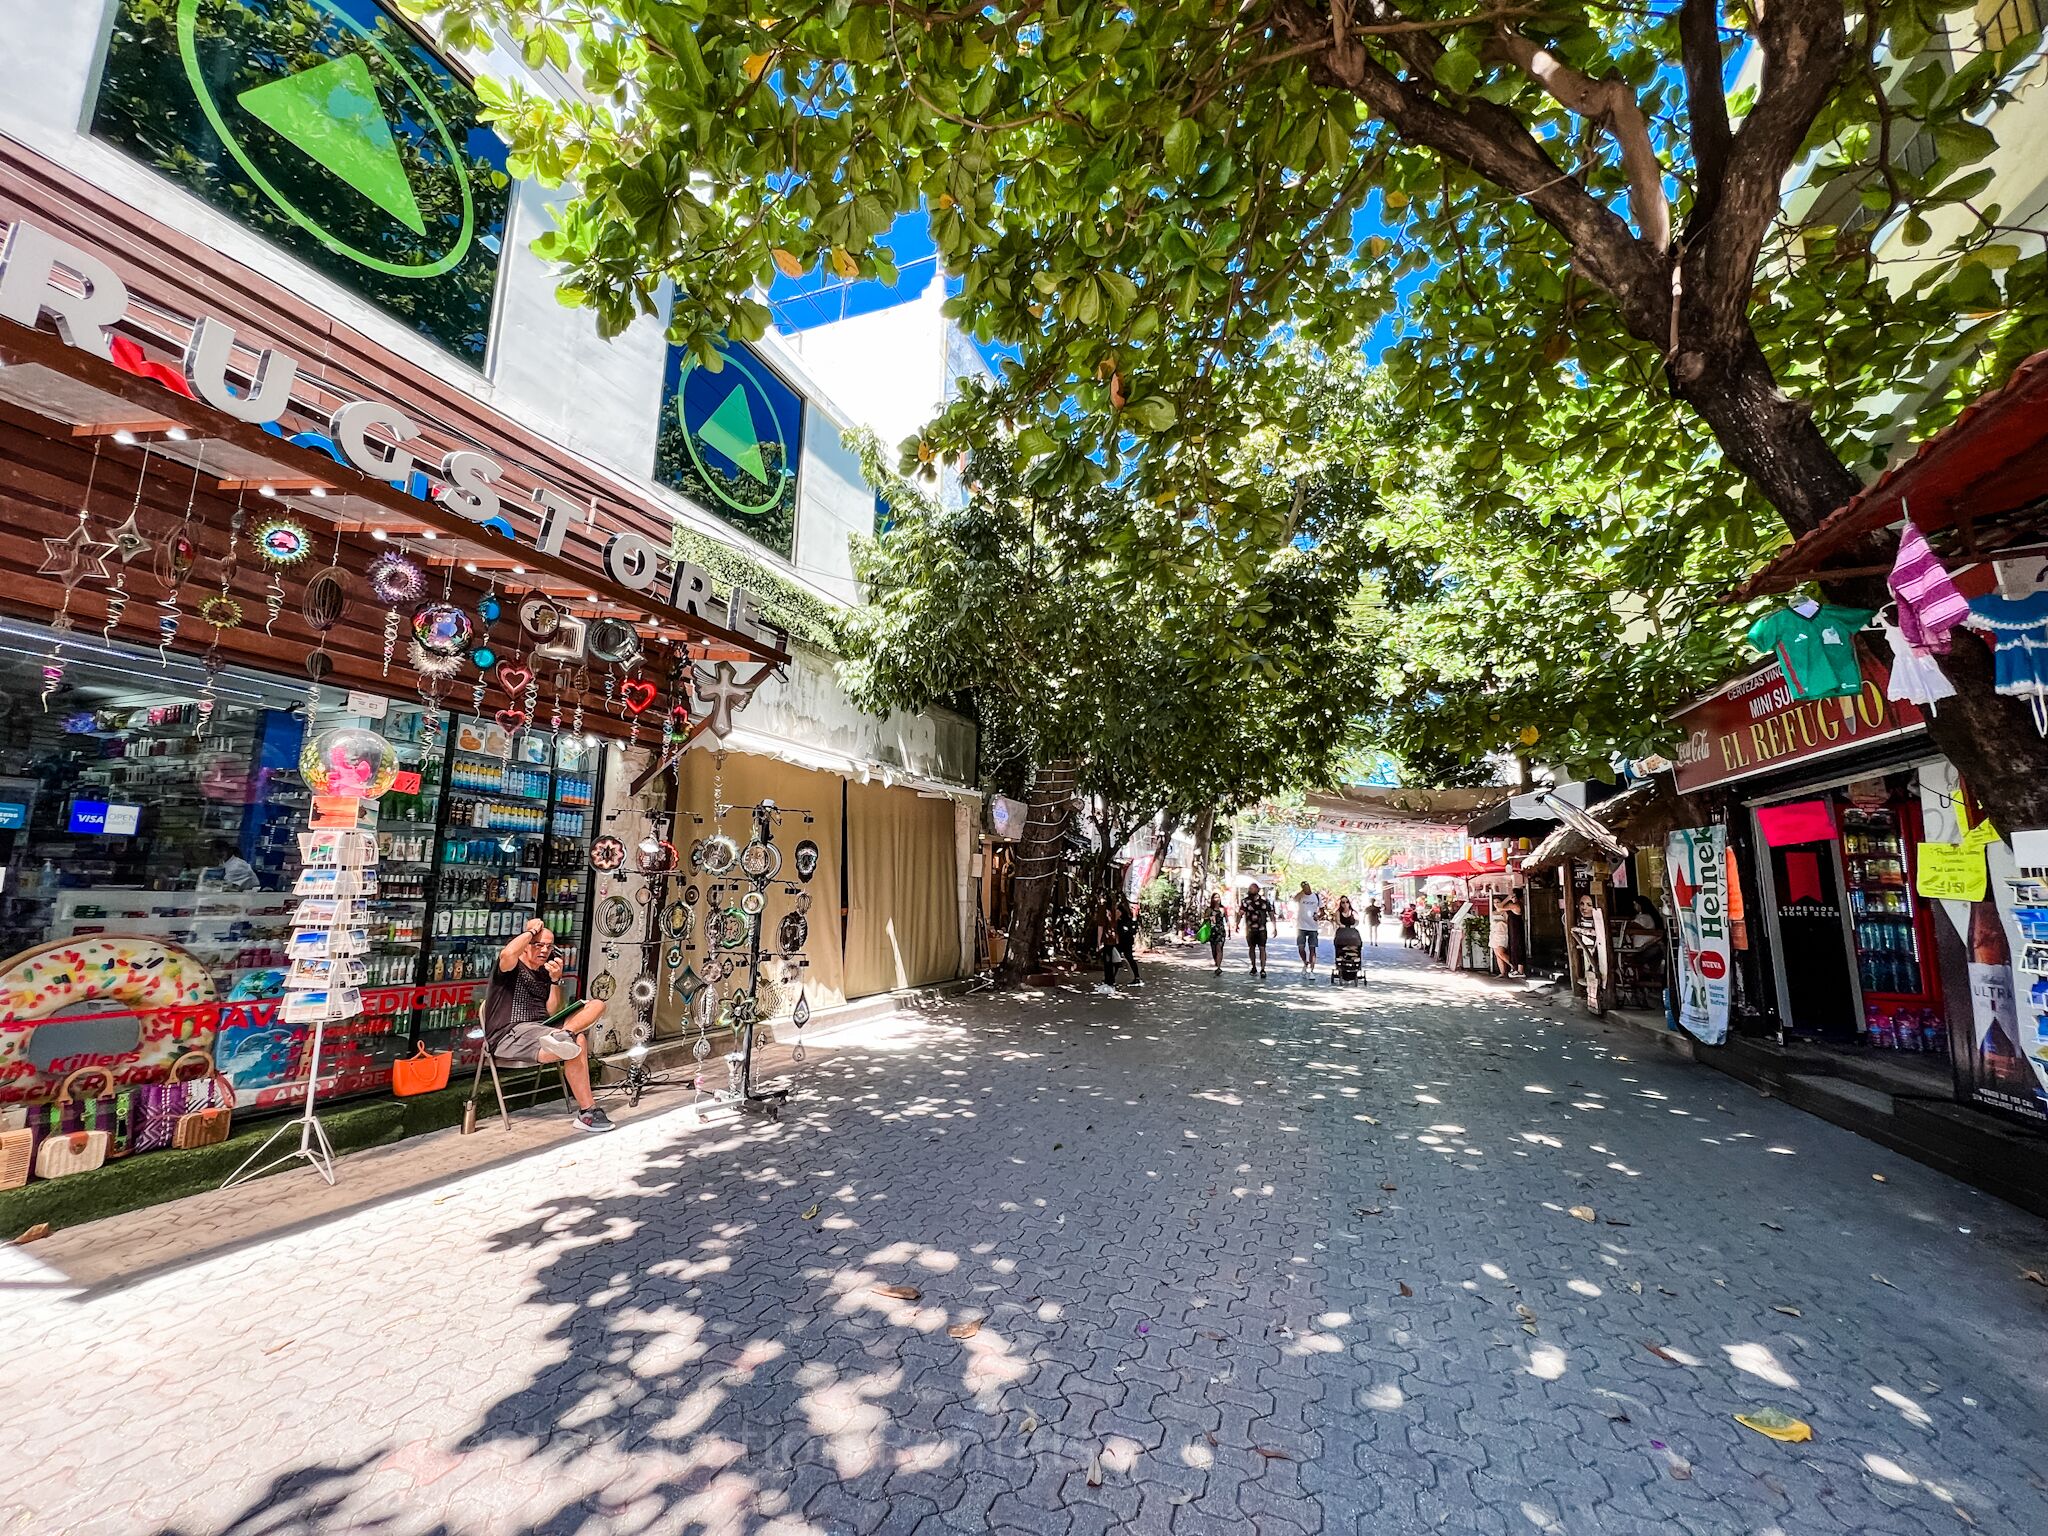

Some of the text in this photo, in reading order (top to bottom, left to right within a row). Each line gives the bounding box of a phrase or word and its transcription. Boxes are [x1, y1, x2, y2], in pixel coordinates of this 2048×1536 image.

[1726, 674, 1765, 701] CERVEZAS
[1748, 692, 1774, 719] MINI
[1719, 731, 1750, 772] EL
[76, 813, 105, 824] VISA
[107, 813, 136, 822] OPEN
[1701, 960, 1723, 970] NUEVA
[1973, 985, 2013, 999] ULTRA
[168, 985, 475, 1038] TRAV EDICINE
[47, 1051, 141, 1074] Killers
